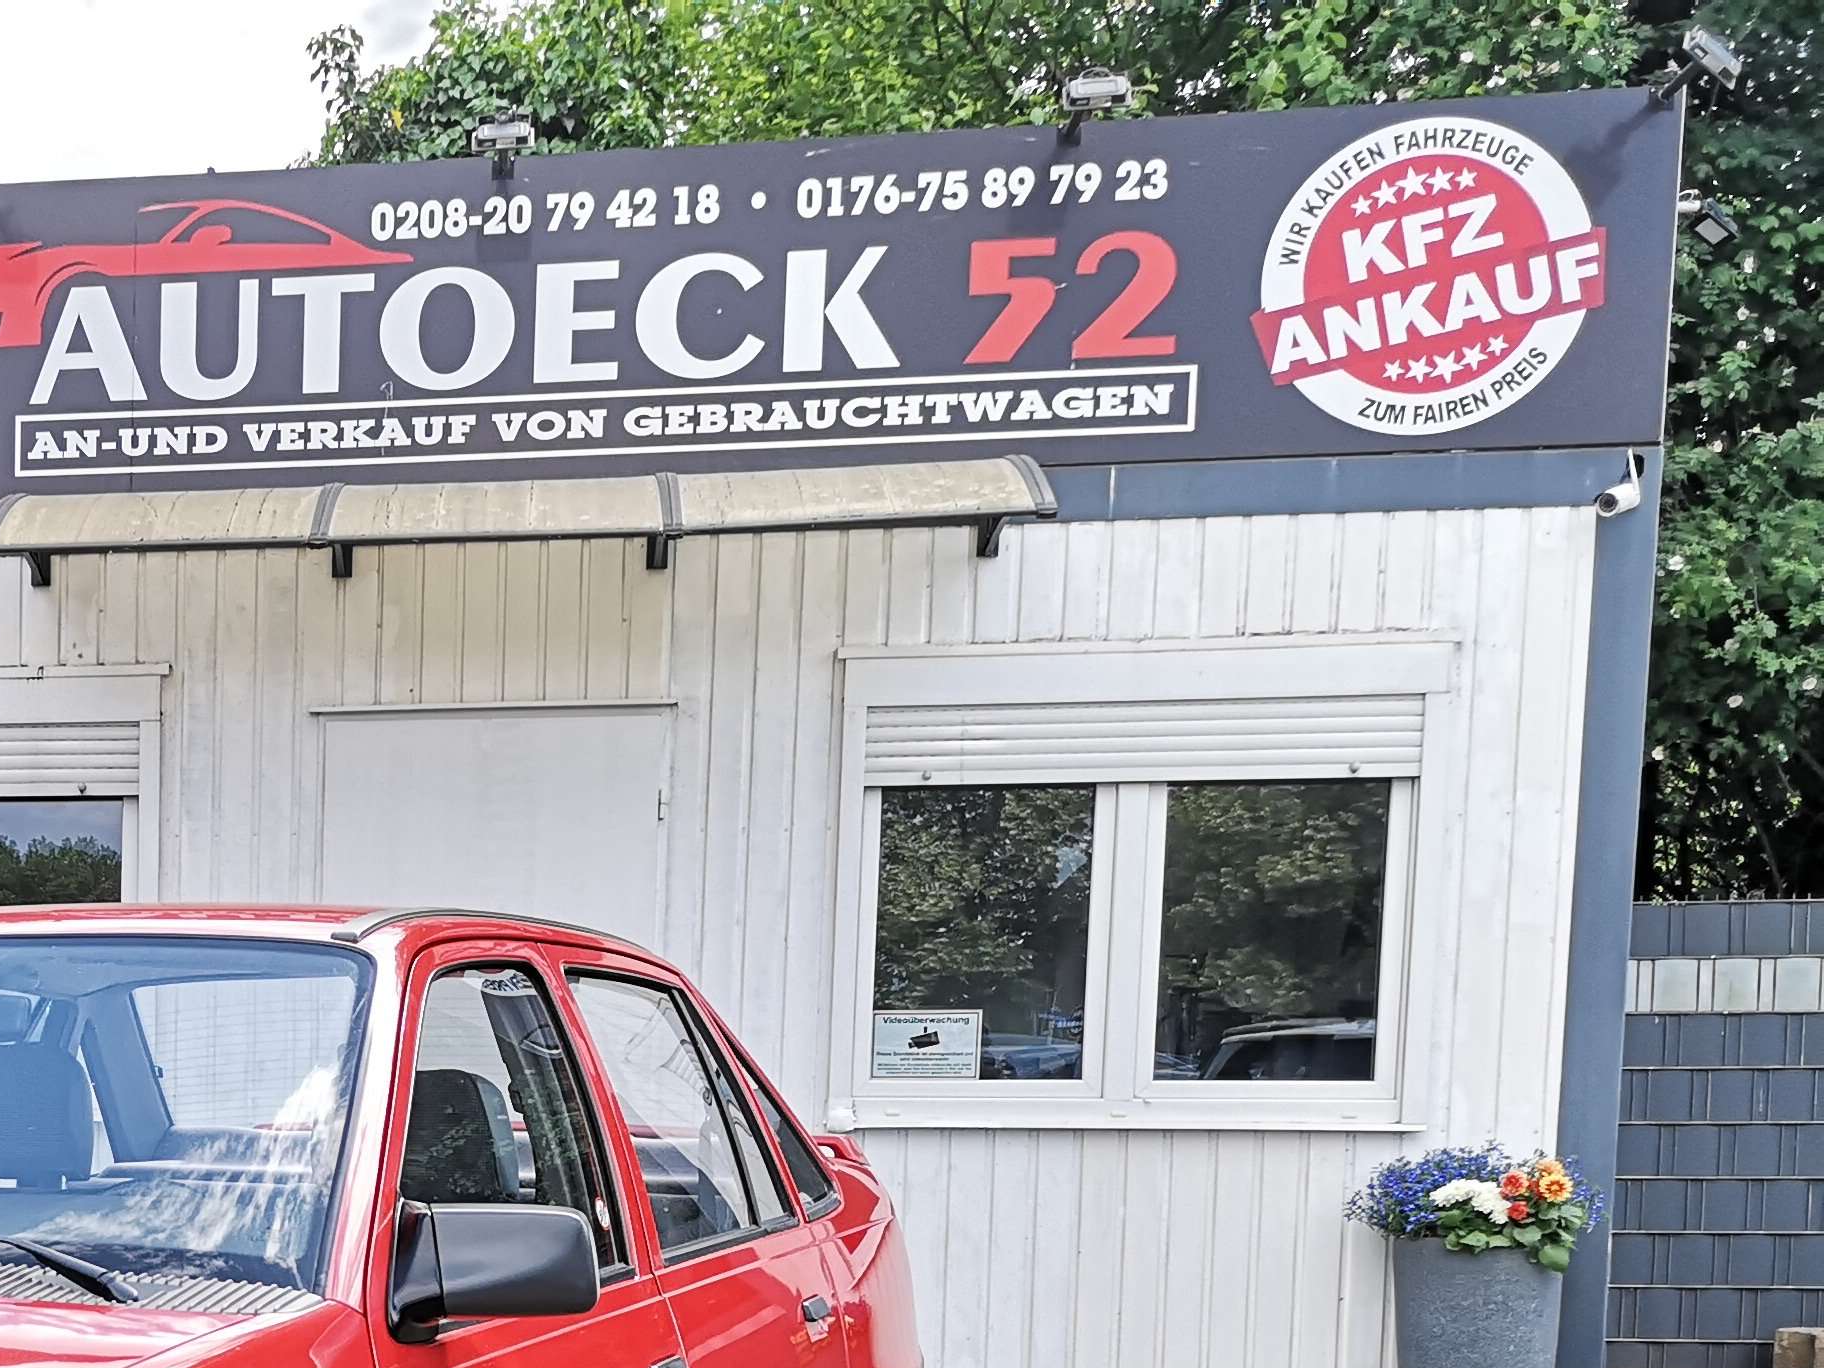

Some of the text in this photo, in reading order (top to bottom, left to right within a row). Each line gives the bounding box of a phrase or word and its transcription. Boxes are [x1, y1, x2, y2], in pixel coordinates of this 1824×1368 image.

[371, 158, 1169, 241] 0208-20 79 42 18 0176-75 89 79 23
[1279, 128, 1534, 266] WIR KAUFEN FAHRZEUGE
[1341, 193, 1504, 284] KFZ
[29, 230, 1178, 405] AUTOECK 52
[1270, 242, 1600, 375] ANKAUF
[27, 383, 1175, 461] AN-UND VERKAUF VON GEBRAUCHTWAGEN
[1358, 347, 1548, 425] ZUM FAIREN PREIS
[883, 1015, 970, 1026] Videoüberwachung
